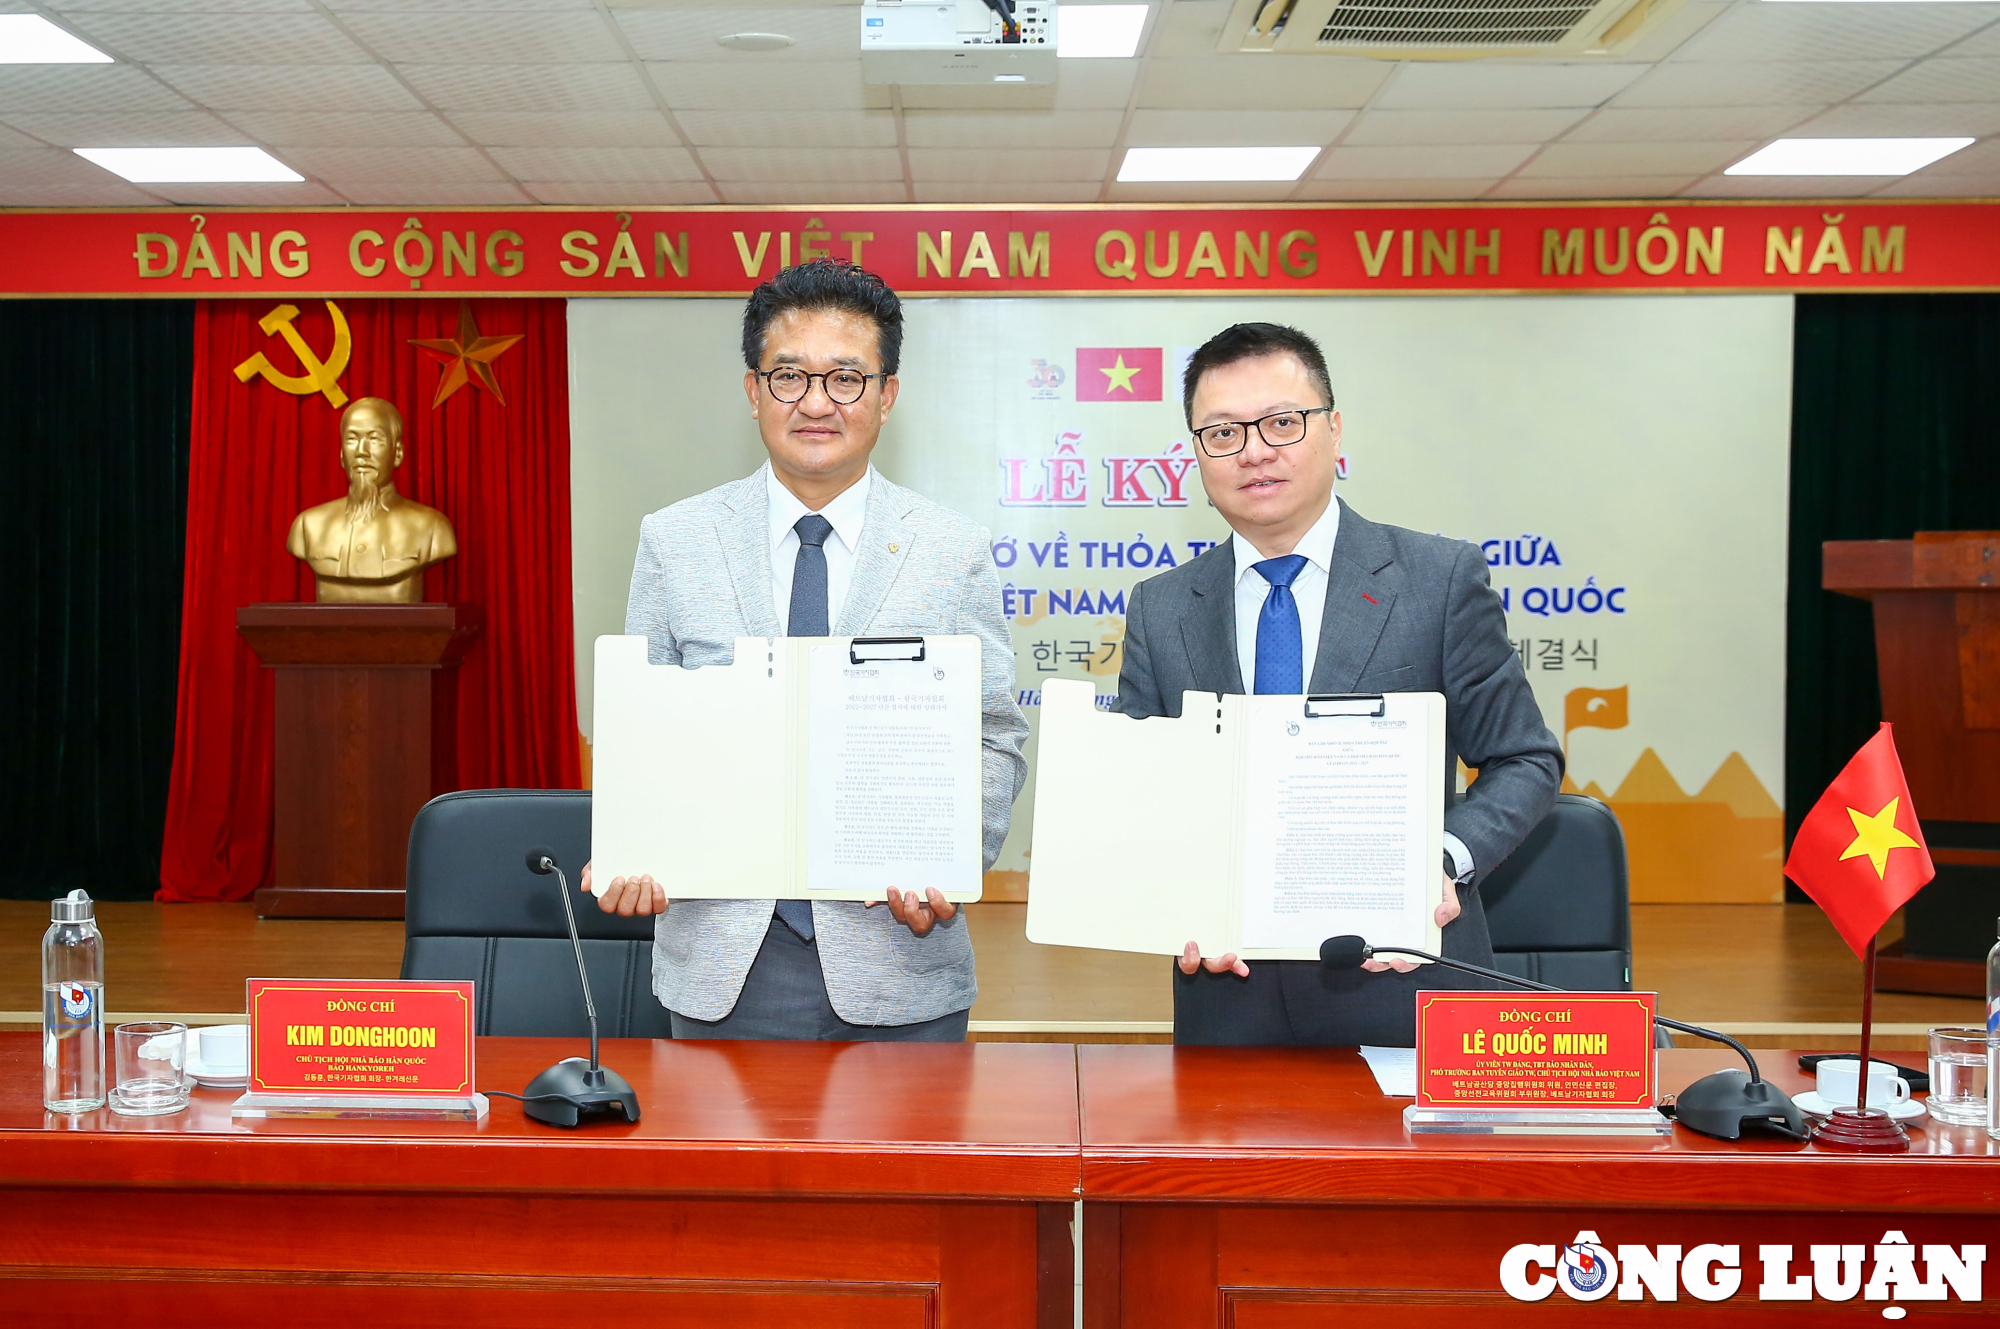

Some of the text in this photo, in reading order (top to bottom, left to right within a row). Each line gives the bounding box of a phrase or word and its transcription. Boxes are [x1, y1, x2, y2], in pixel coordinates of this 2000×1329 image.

[133, 213, 310, 278] ĐẢNG
[348, 217, 525, 289] CỘNG
[560, 213, 690, 279] SẢN
[916, 230, 1051, 279] NAM
[1094, 229, 1319, 280] QUANG
[1354, 229, 1501, 278] VINH
[1541, 213, 1725, 277] MUÔN
[1764, 213, 1907, 276] NĂM
[1003, 430, 1197, 503] LỄ KÝ
[1028, 531, 1069, 568] VỀ
[1080, 533, 1177, 568] THỎA
[1481, 534, 1563, 566] GIỮA
[1049, 588, 1126, 616] NAM
[1522, 576, 1626, 617] QUỐC
[327, 998, 395, 1013] ĐỒNG CHÍ
[1499, 1008, 1572, 1023] ĐỒNG CHÍ
[287, 1025, 436, 1048] KIM DONGHOON
[1463, 1026, 1608, 1057] LÊ QUỐC MINH
[334, 1056, 349, 1064] HỘI
[1568, 1070, 1580, 1078] HỘI
[1609, 1070, 1624, 1078] VIỆT
[1625, 1070, 1640, 1078] NAM
[1452, 1080, 1494, 1088] 베트남공산당
[1496, 1080, 1545, 1089] 중앙집행위원회
[1564, 1081, 1593, 1089] 인민신문
[1453, 1089, 1517, 1098] 중앙선전교육위원회
[1550, 1090, 1600, 1098] 베트남기자협회
[1601, 1090, 1616, 1099] 회장
